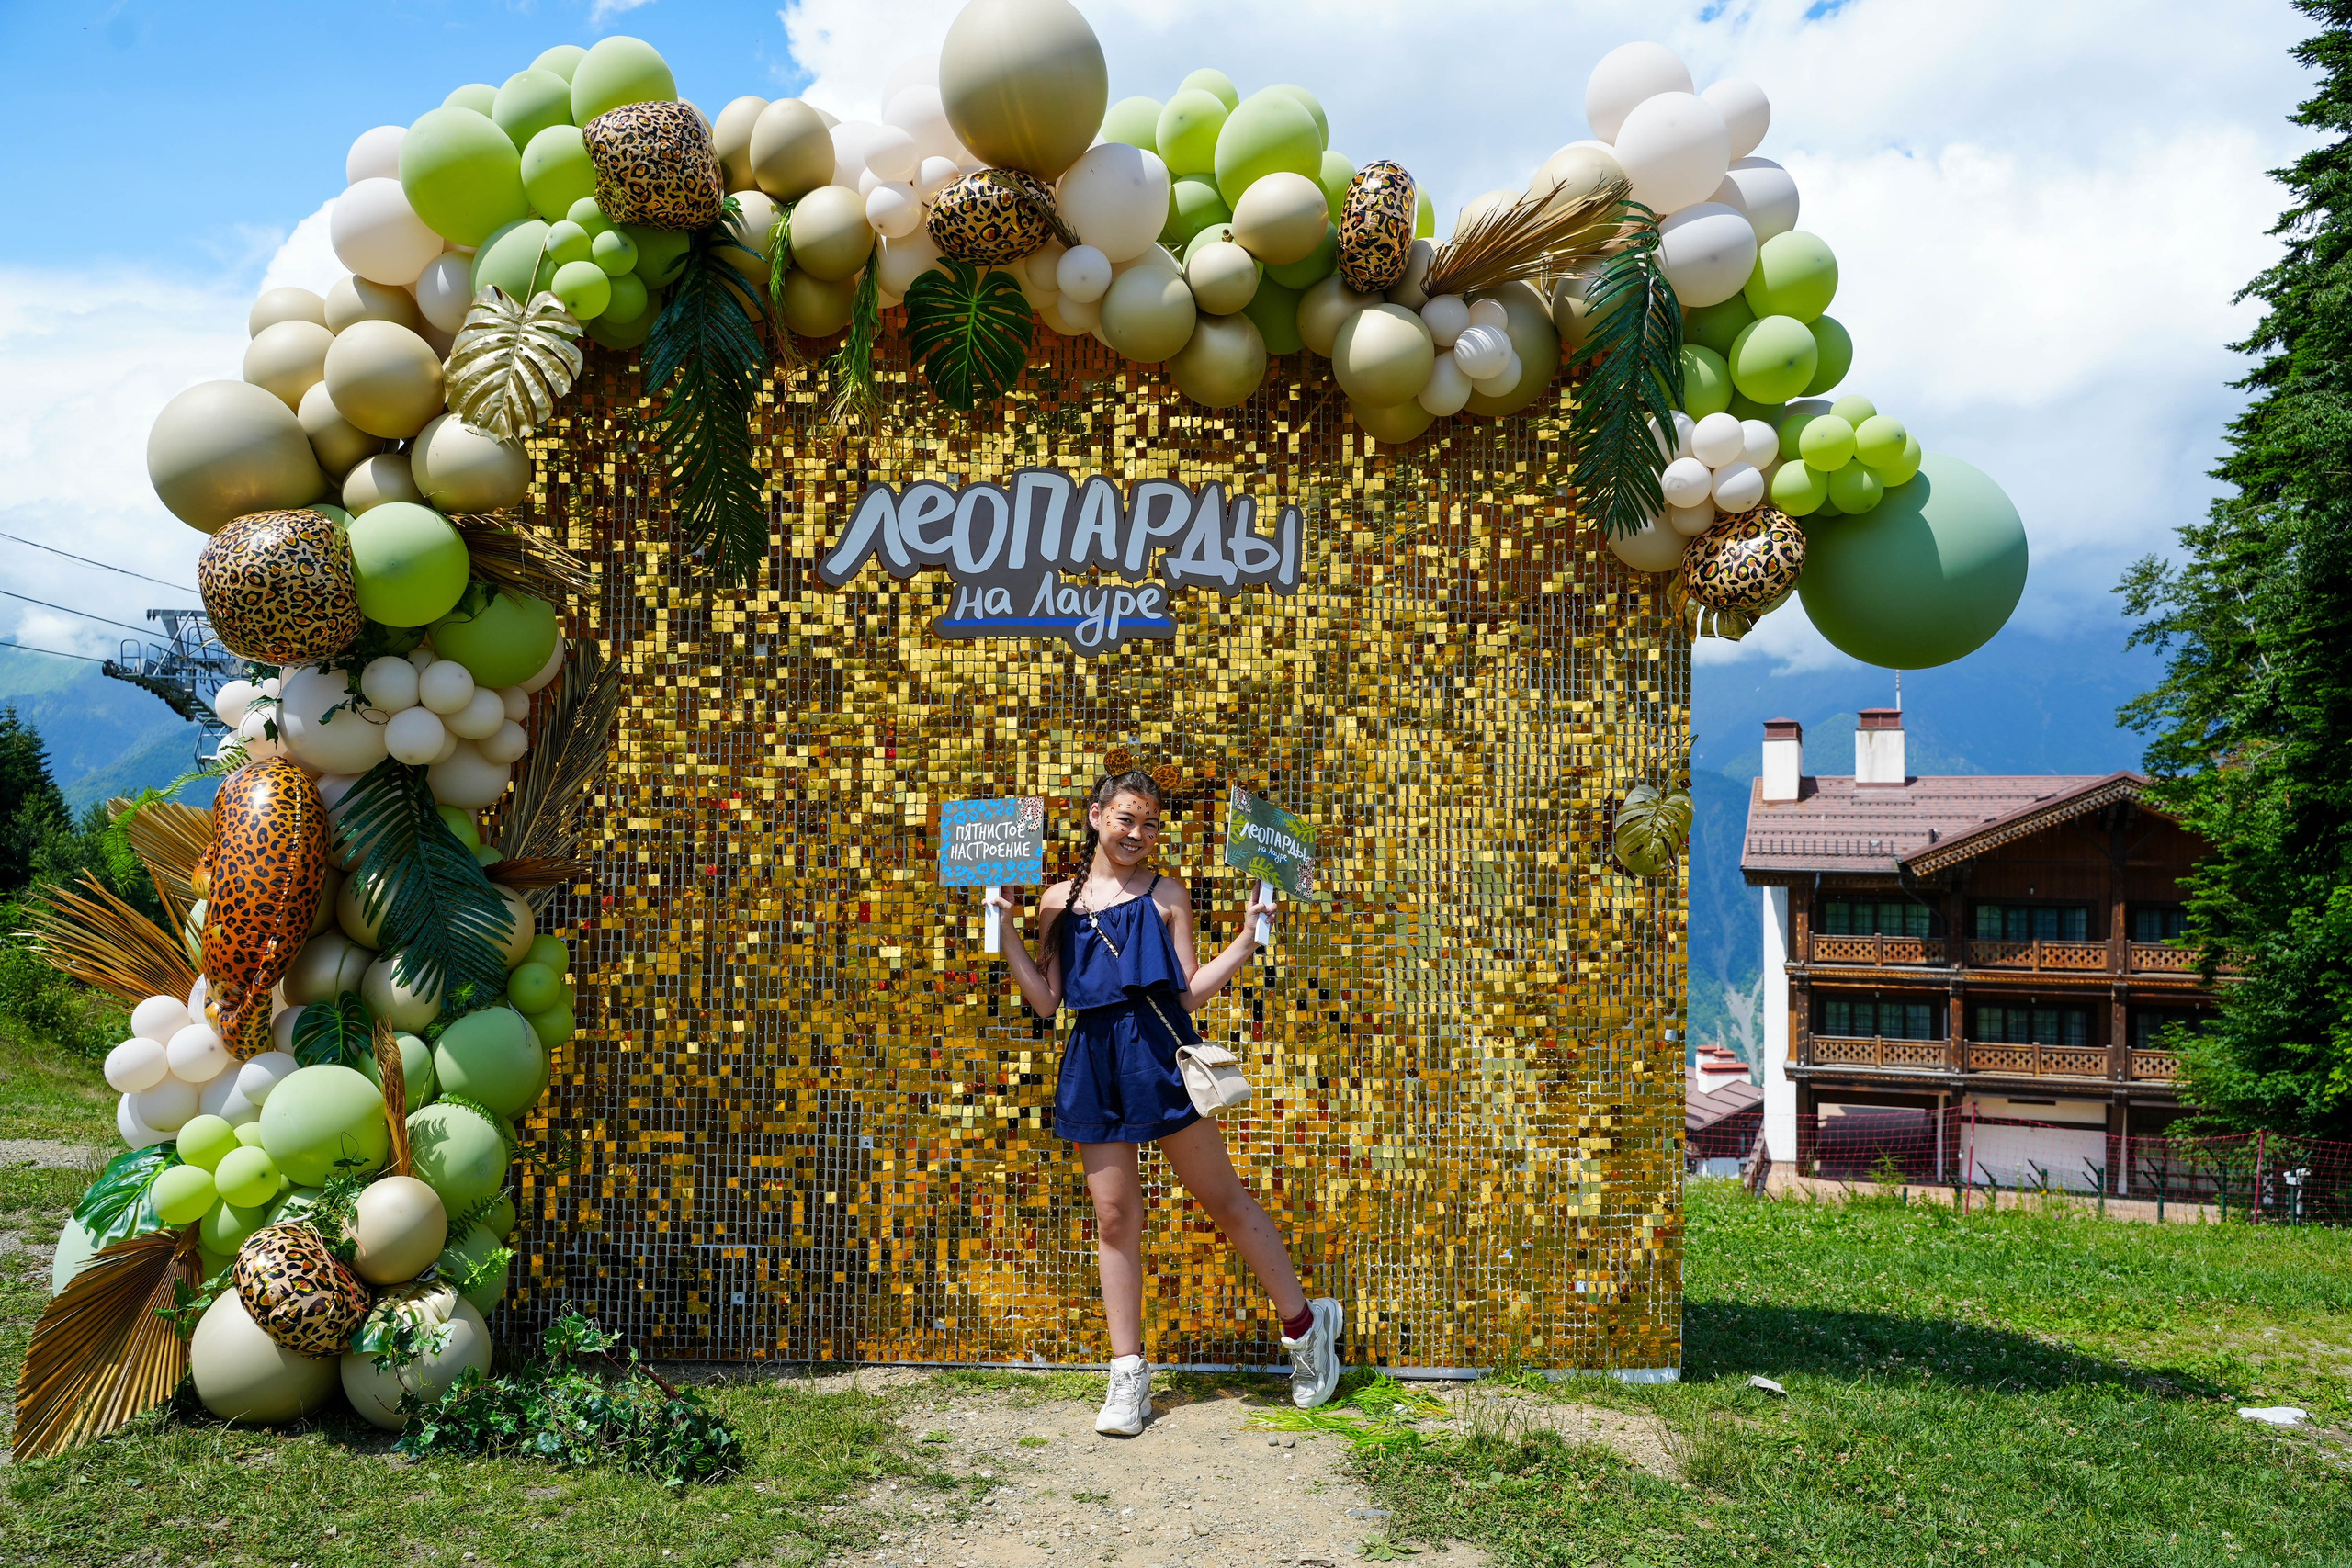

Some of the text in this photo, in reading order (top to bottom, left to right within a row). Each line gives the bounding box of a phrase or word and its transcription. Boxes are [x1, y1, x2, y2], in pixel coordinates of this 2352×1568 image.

[955, 571, 1164, 647] на Лауре
[956, 821, 1025, 841] ПЯТНИСТОЕ
[950, 841, 1031, 861] НАСТРОЕНИЕ
[1268, 846, 1288, 863] Лауре
